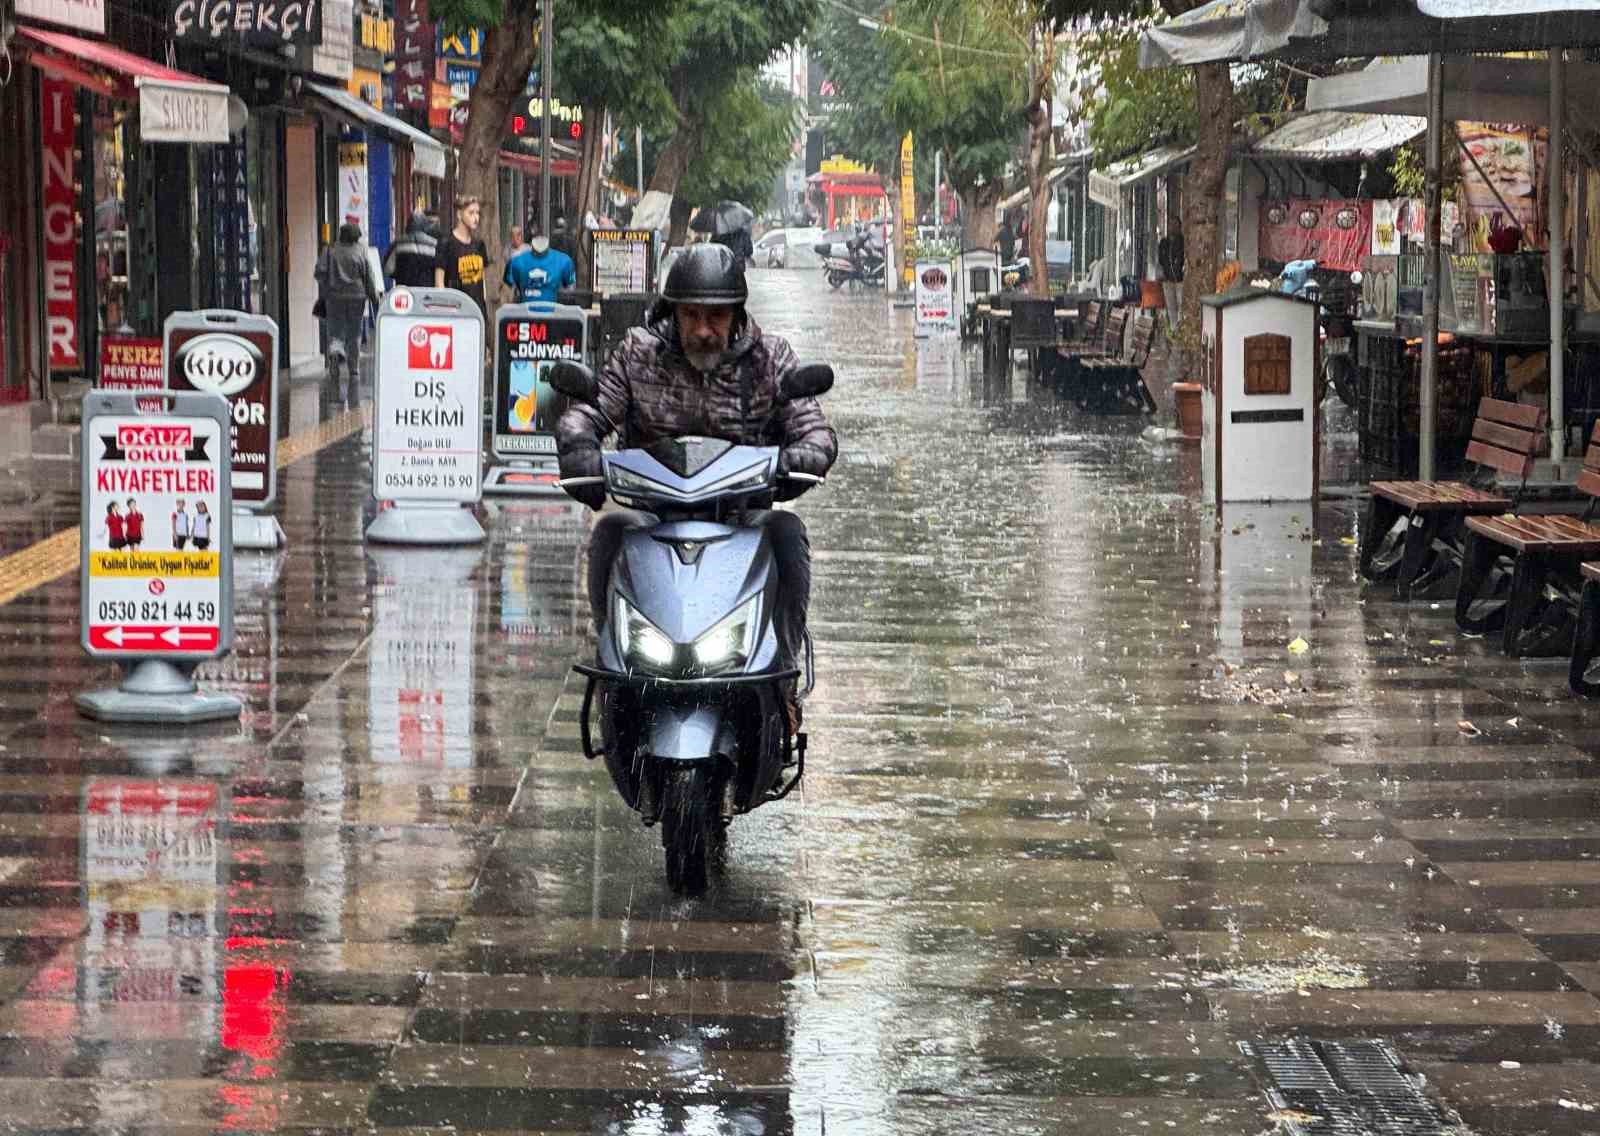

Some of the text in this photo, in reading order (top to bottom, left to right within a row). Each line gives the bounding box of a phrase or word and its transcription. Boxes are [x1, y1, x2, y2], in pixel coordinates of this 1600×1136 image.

[162, 94, 209, 133] SINGER
[43, 66, 77, 358] INGER
[506, 322, 547, 342] GSM
[414, 376, 446, 405] DİŞ
[395, 405, 464, 427] HEKİMİ
[128, 450, 183, 462] OKUL
[385, 473, 473, 488] 0534 592 15 90
[99, 601, 215, 621] 0530 821 44 59
